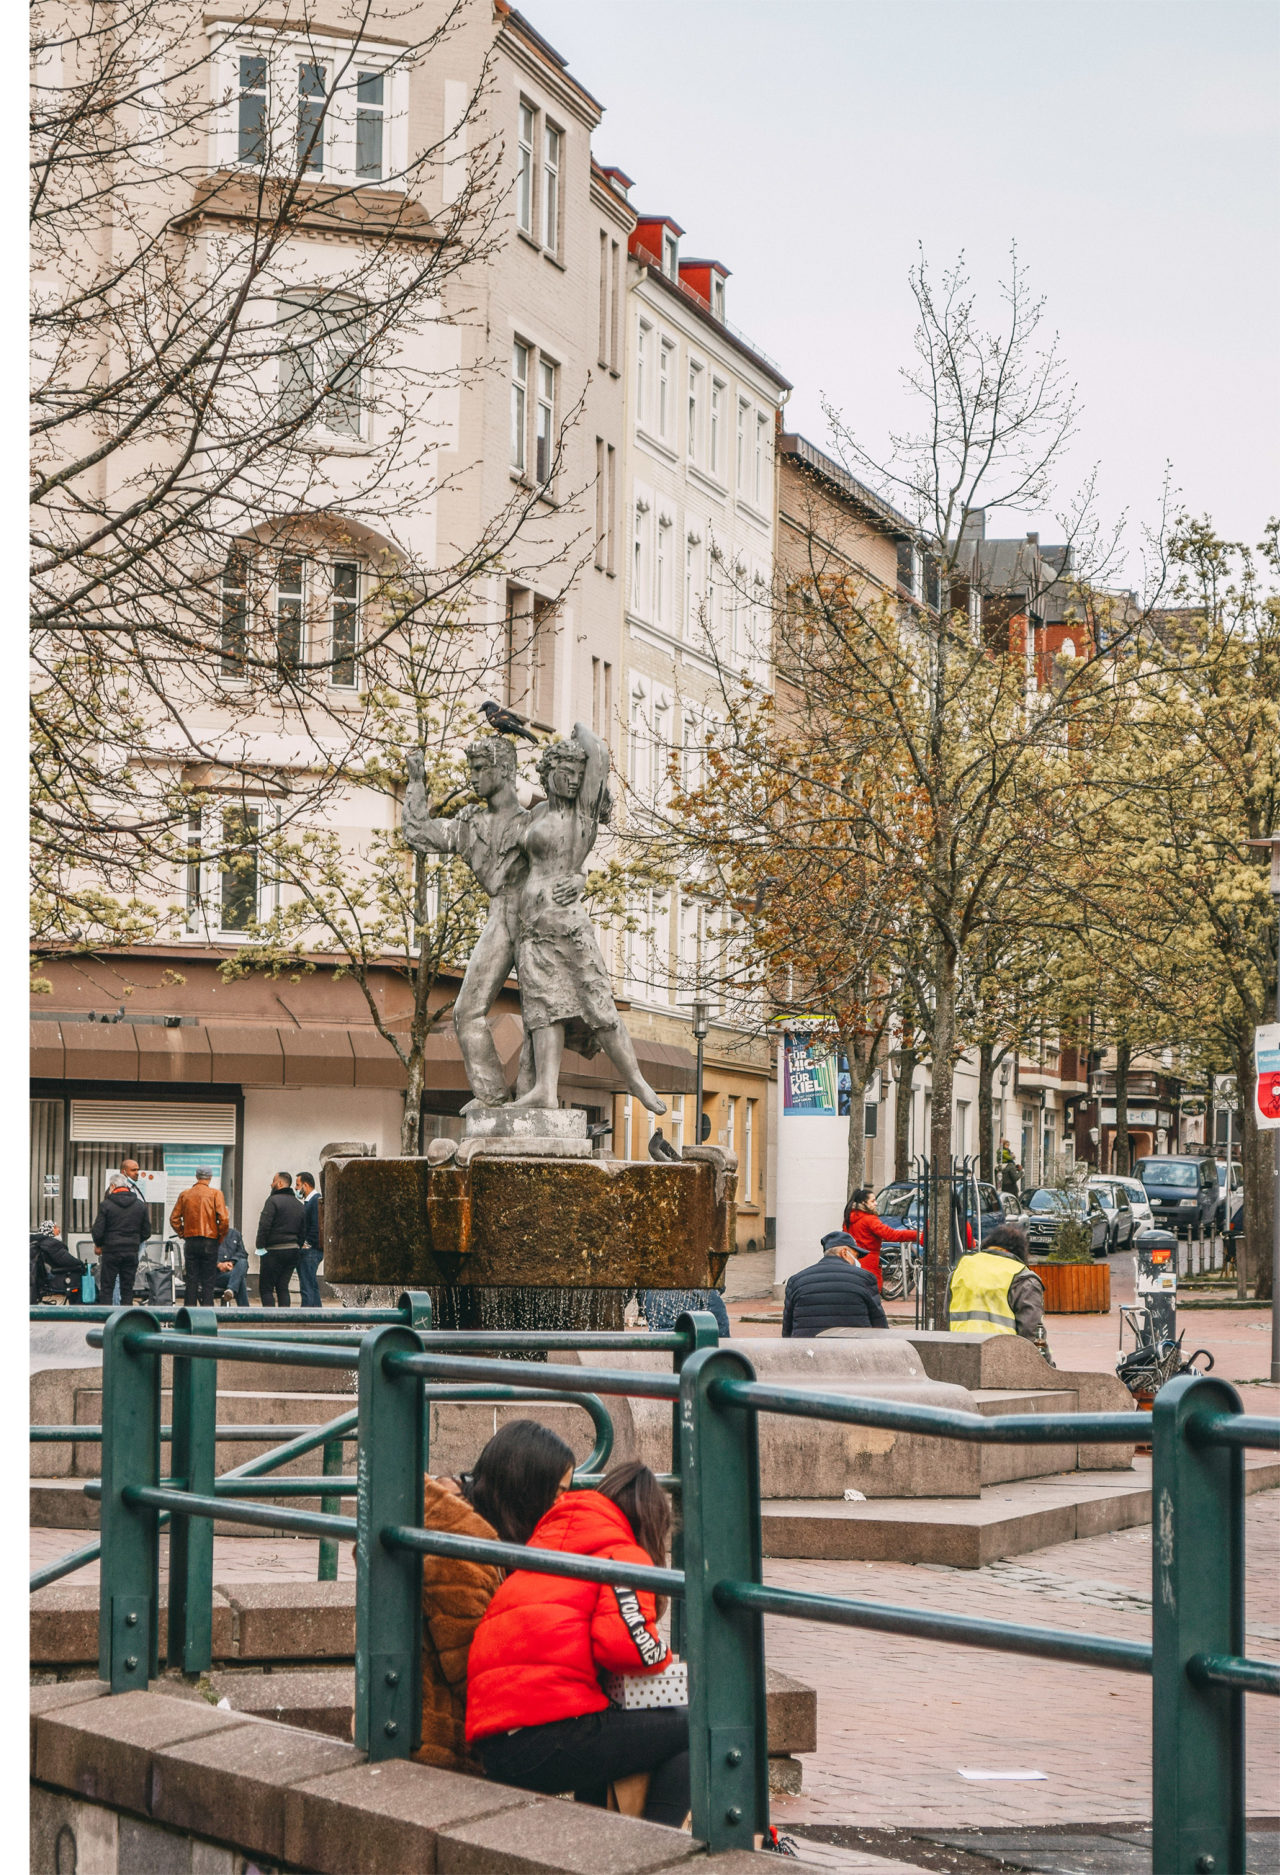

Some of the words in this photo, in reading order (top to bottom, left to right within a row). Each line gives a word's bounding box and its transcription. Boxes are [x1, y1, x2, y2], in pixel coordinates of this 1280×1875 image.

[788, 1049, 807, 1060] FÜR
[790, 1071, 810, 1083] FÜR
[791, 1079, 823, 1095] KIEL
[620, 1595, 645, 1627] YORK
